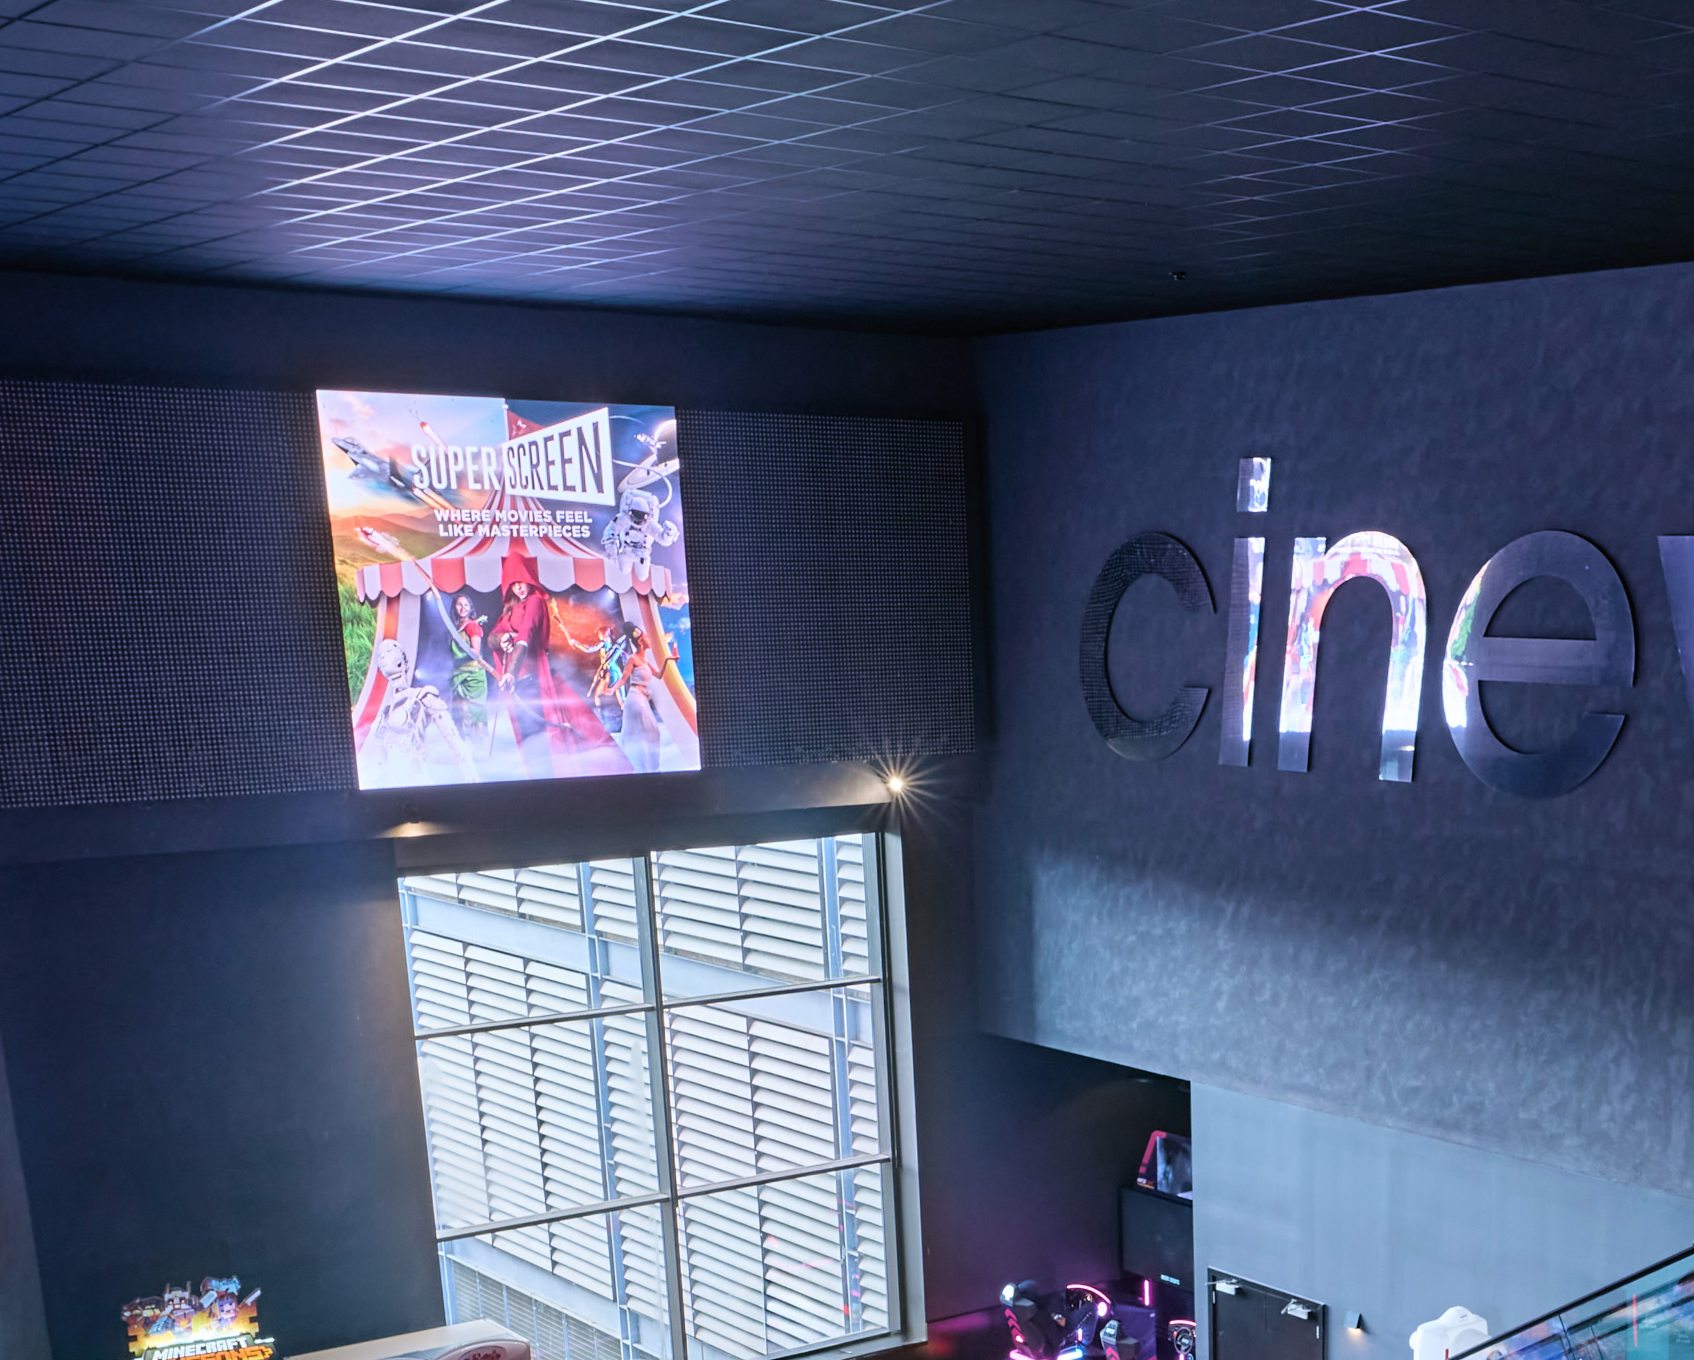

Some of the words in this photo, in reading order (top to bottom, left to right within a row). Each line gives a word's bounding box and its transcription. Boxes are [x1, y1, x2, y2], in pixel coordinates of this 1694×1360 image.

[411, 444, 502, 490] SUPER
[506, 420, 605, 495] SCREEN
[434, 509, 491, 522] WHERE
[495, 509, 552, 523] MOVIES
[556, 510, 593, 524] FEEL
[438, 524, 474, 537] LIKE
[477, 524, 591, 538] MASTERPIECES
